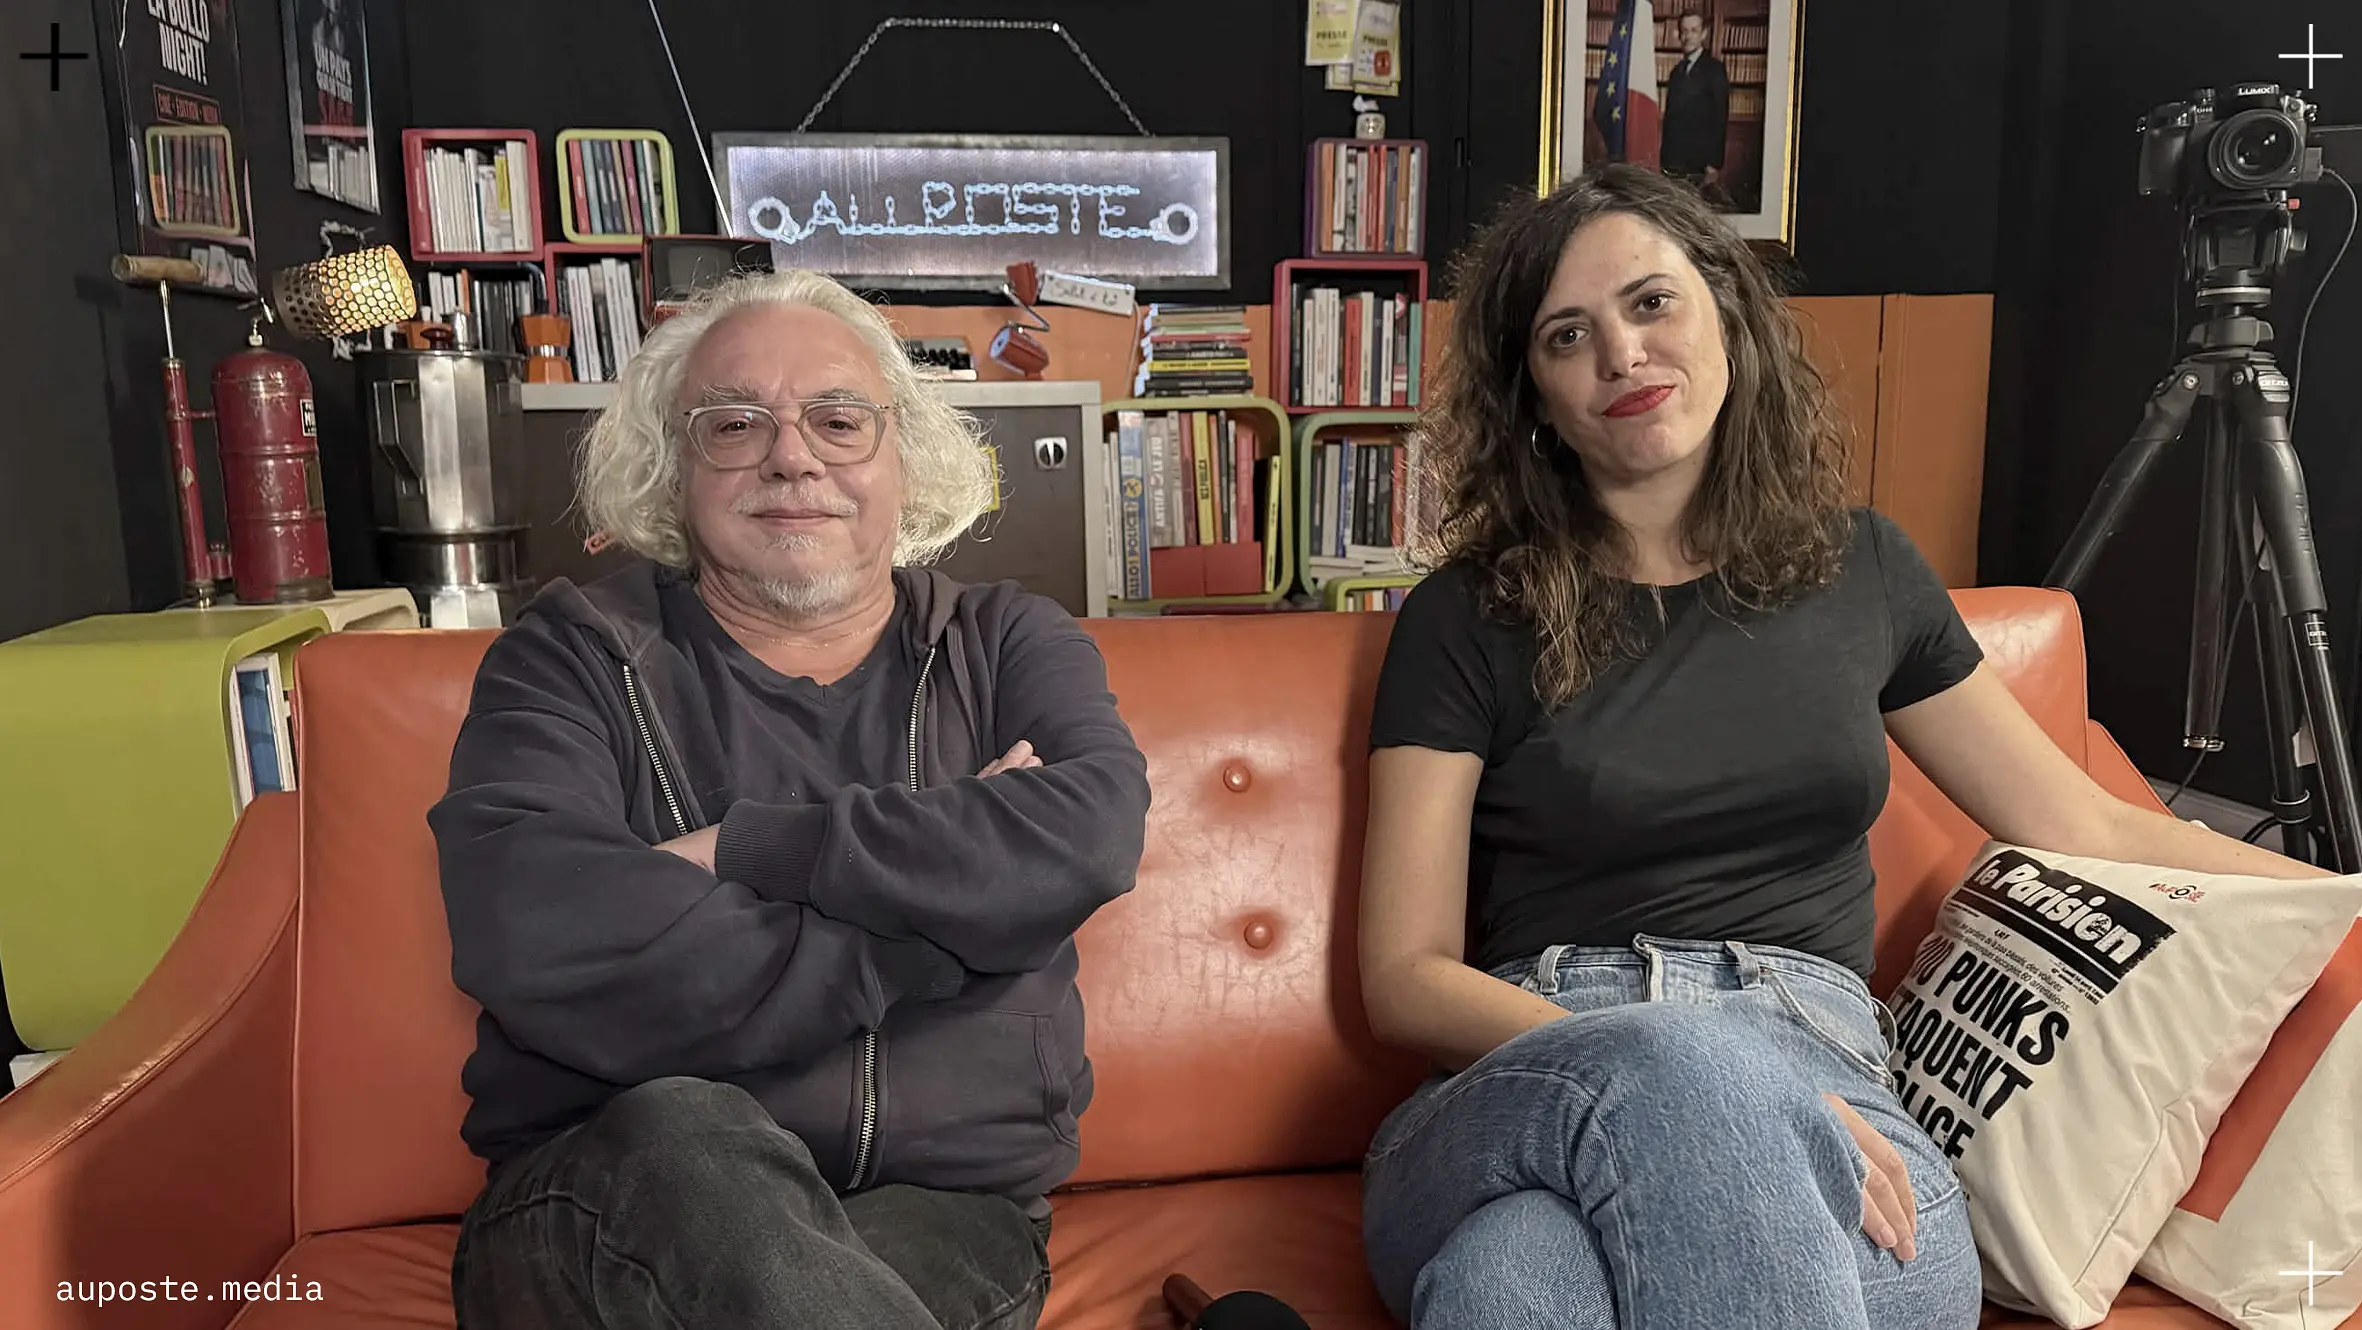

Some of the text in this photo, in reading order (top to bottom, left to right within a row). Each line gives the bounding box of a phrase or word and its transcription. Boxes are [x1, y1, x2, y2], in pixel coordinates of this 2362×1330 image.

[159, 21, 208, 86] NIGHT!
[2237, 87, 2271, 96] LUMIX
[1991, 862, 2142, 965] Parisien
[1933, 950, 2070, 1066] PUNKS
